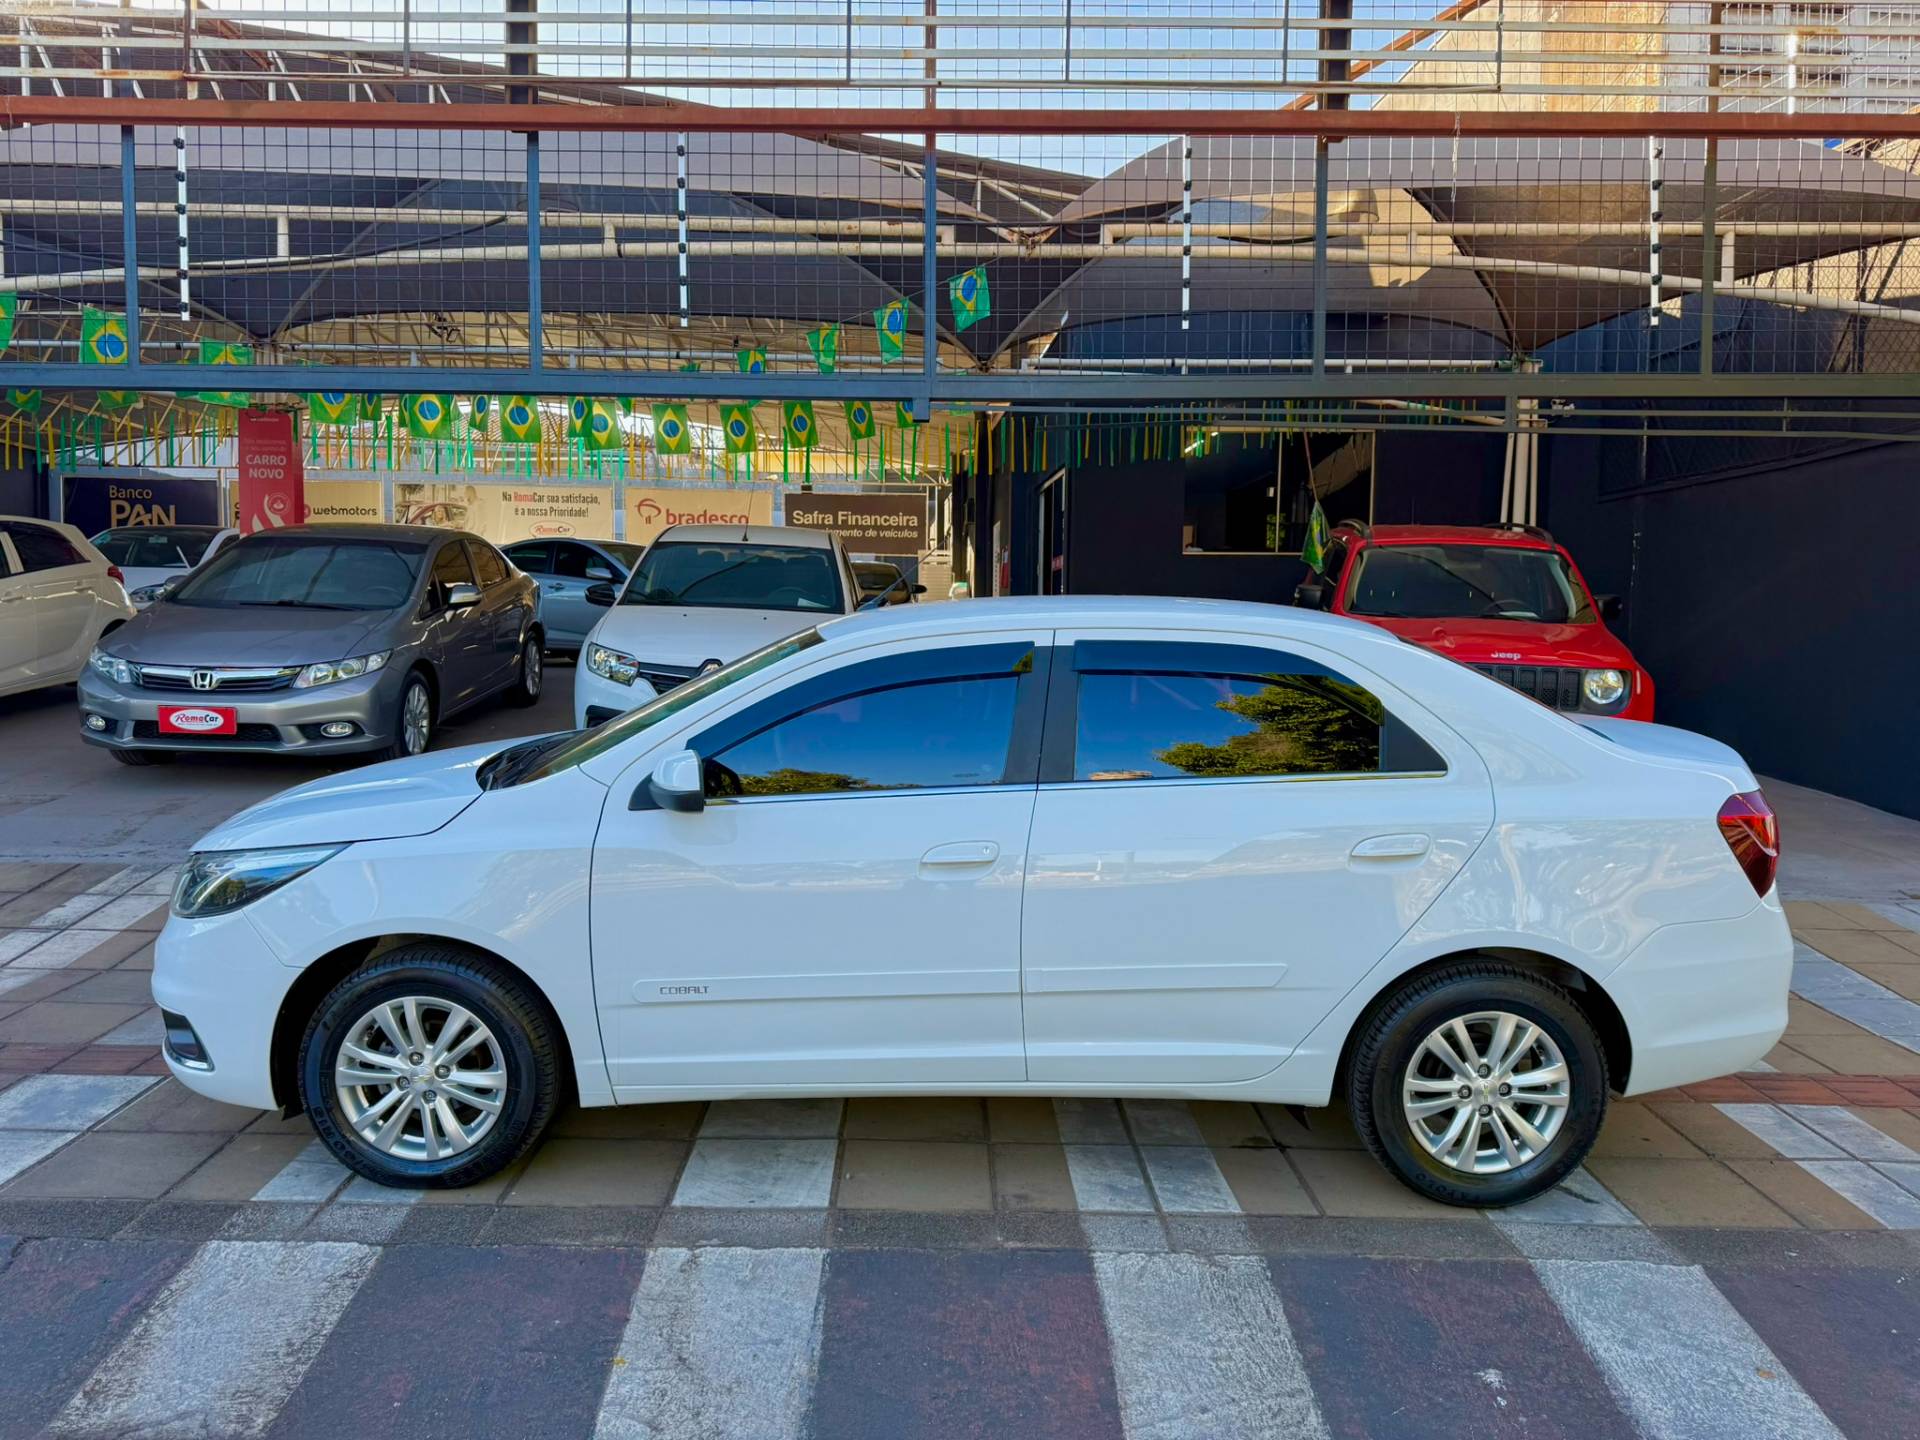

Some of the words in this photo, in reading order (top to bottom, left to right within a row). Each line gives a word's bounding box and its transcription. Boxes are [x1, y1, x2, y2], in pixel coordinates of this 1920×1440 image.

[246, 454, 287, 466] CARRO
[248, 467, 284, 479] NOVO
[109, 485, 152, 499] Banco
[502, 491, 512, 502] Na
[513, 491, 545, 503] RomaCar
[546, 494, 560, 503] sua
[561, 493, 601, 505] satisfação,
[111, 500, 176, 528] PAN
[313, 505, 377, 516] webmotors
[520, 508, 526, 516] a
[527, 508, 548, 517] nossa
[549, 506, 589, 518] Prioridade!
[665, 508, 749, 526] bradesco
[792, 510, 833, 525] Safra
[837, 511, 918, 527] Financeira
[864, 528, 877, 538] de
[879, 529, 918, 538] veículos
[1490, 650, 1521, 661] Jeep
[175, 713, 219, 723] RomaCar
[660, 985, 709, 995] COBALT
